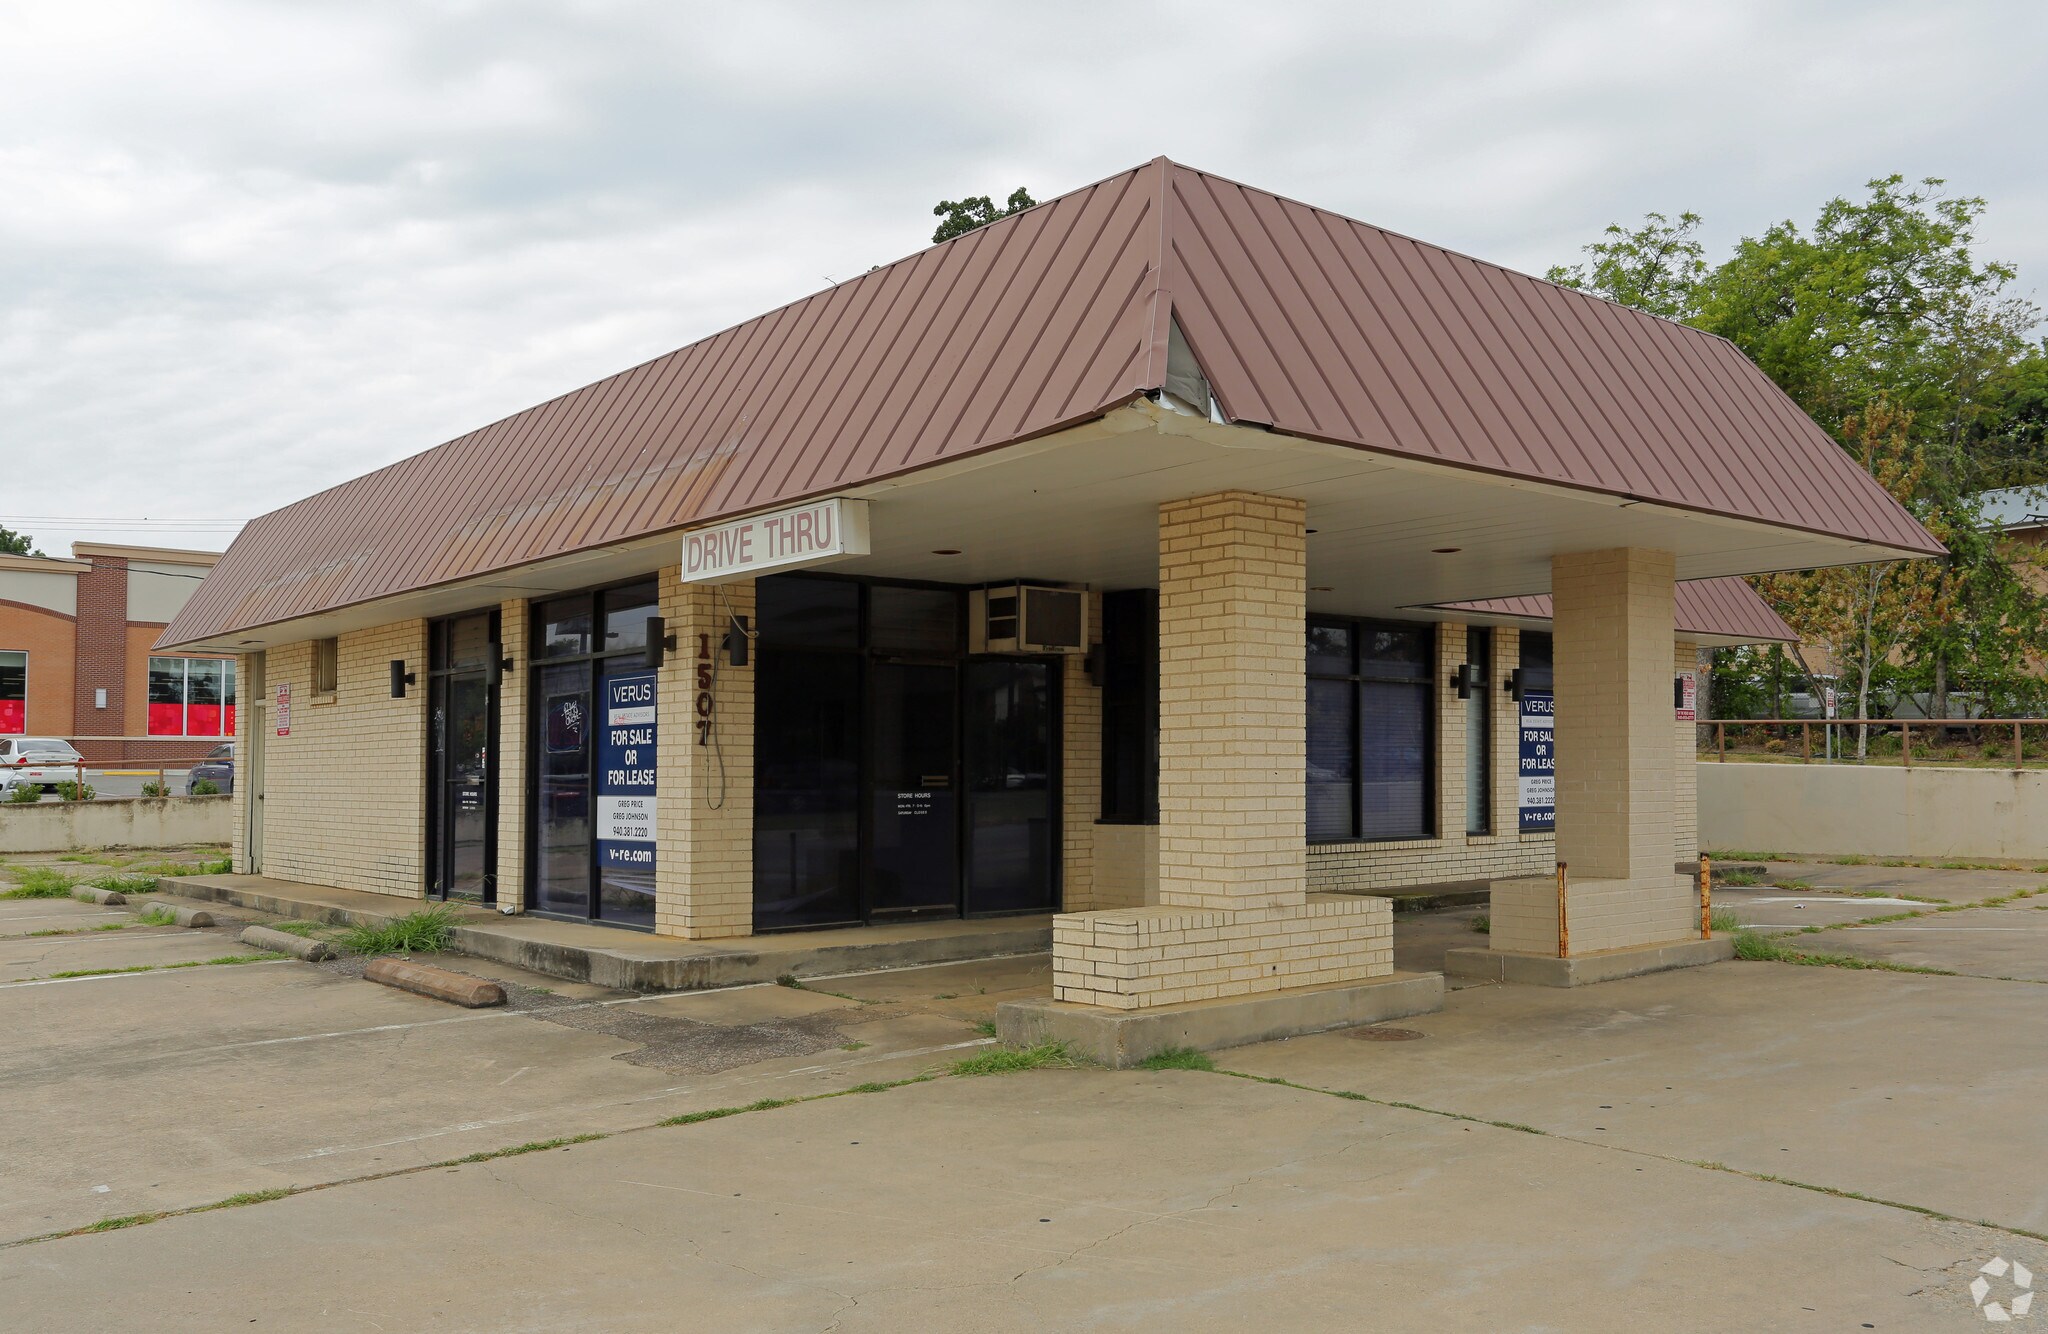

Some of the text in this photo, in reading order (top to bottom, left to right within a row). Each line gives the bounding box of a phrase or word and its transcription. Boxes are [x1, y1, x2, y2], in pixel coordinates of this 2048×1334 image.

[687, 506, 832, 573] DRIVE THRU
[613, 683, 651, 703] VERUS
[696, 633, 713, 746] 1507
[611, 728, 653, 746] FOR SALE
[1524, 730, 1554, 742] FOR SAL
[625, 749, 637, 766] OR
[1536, 744, 1547, 756] OR
[1521, 758, 1555, 770] FOR LEAS
[608, 768, 655, 786] FOR LEASE
[617, 800, 643, 808] GREG PRICE
[612, 812, 649, 821] GREG JOHNSON
[612, 826, 648, 838] 940.381.2220
[609, 848, 652, 863] v-re.com
